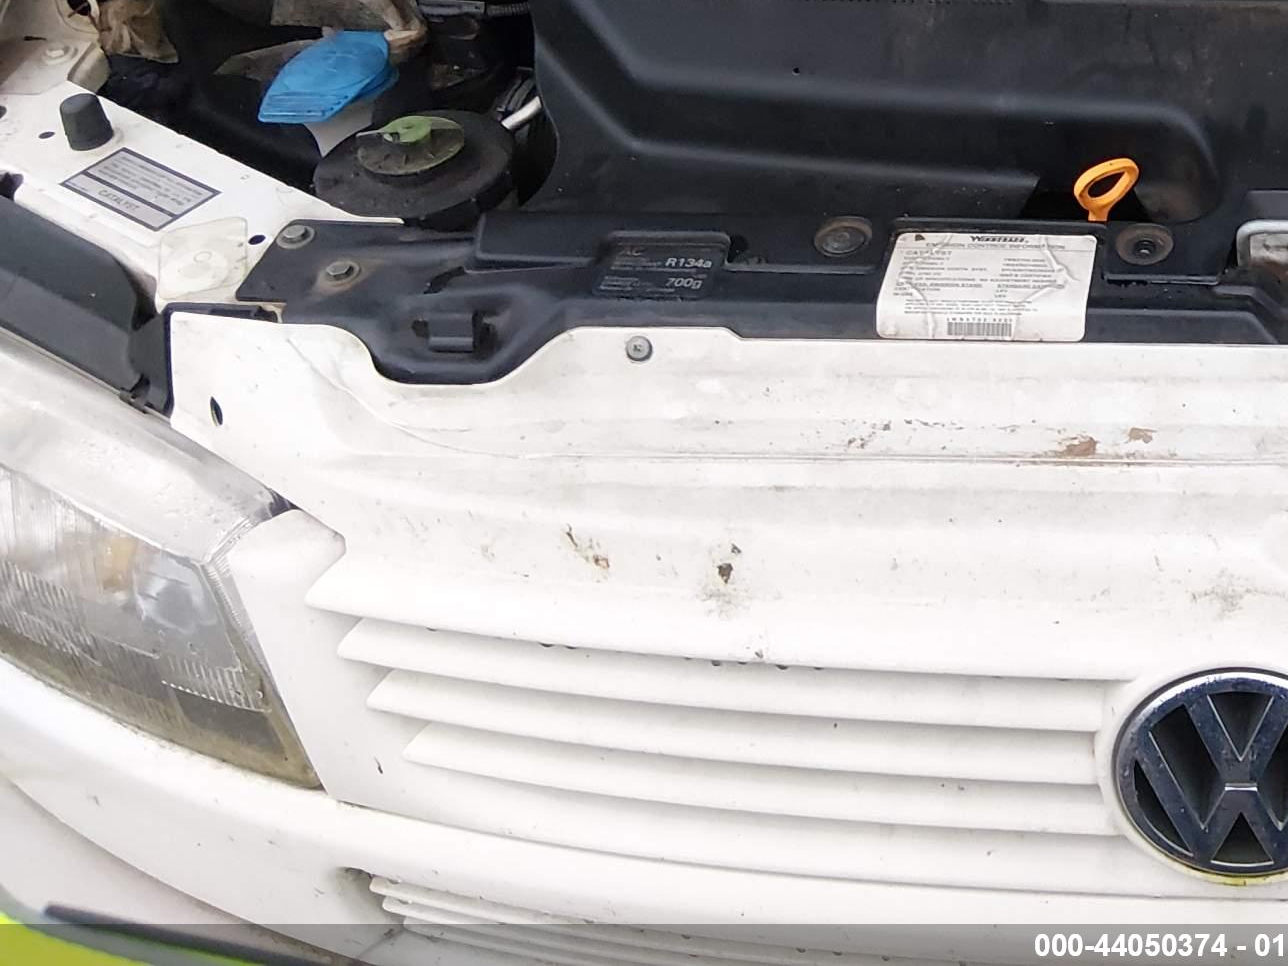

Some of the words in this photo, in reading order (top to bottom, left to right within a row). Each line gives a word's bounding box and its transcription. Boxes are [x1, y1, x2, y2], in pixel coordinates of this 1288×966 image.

[98, 189, 140, 210] CATALYST
[665, 257, 712, 269] R134a
[665, 278, 702, 289] 700g
